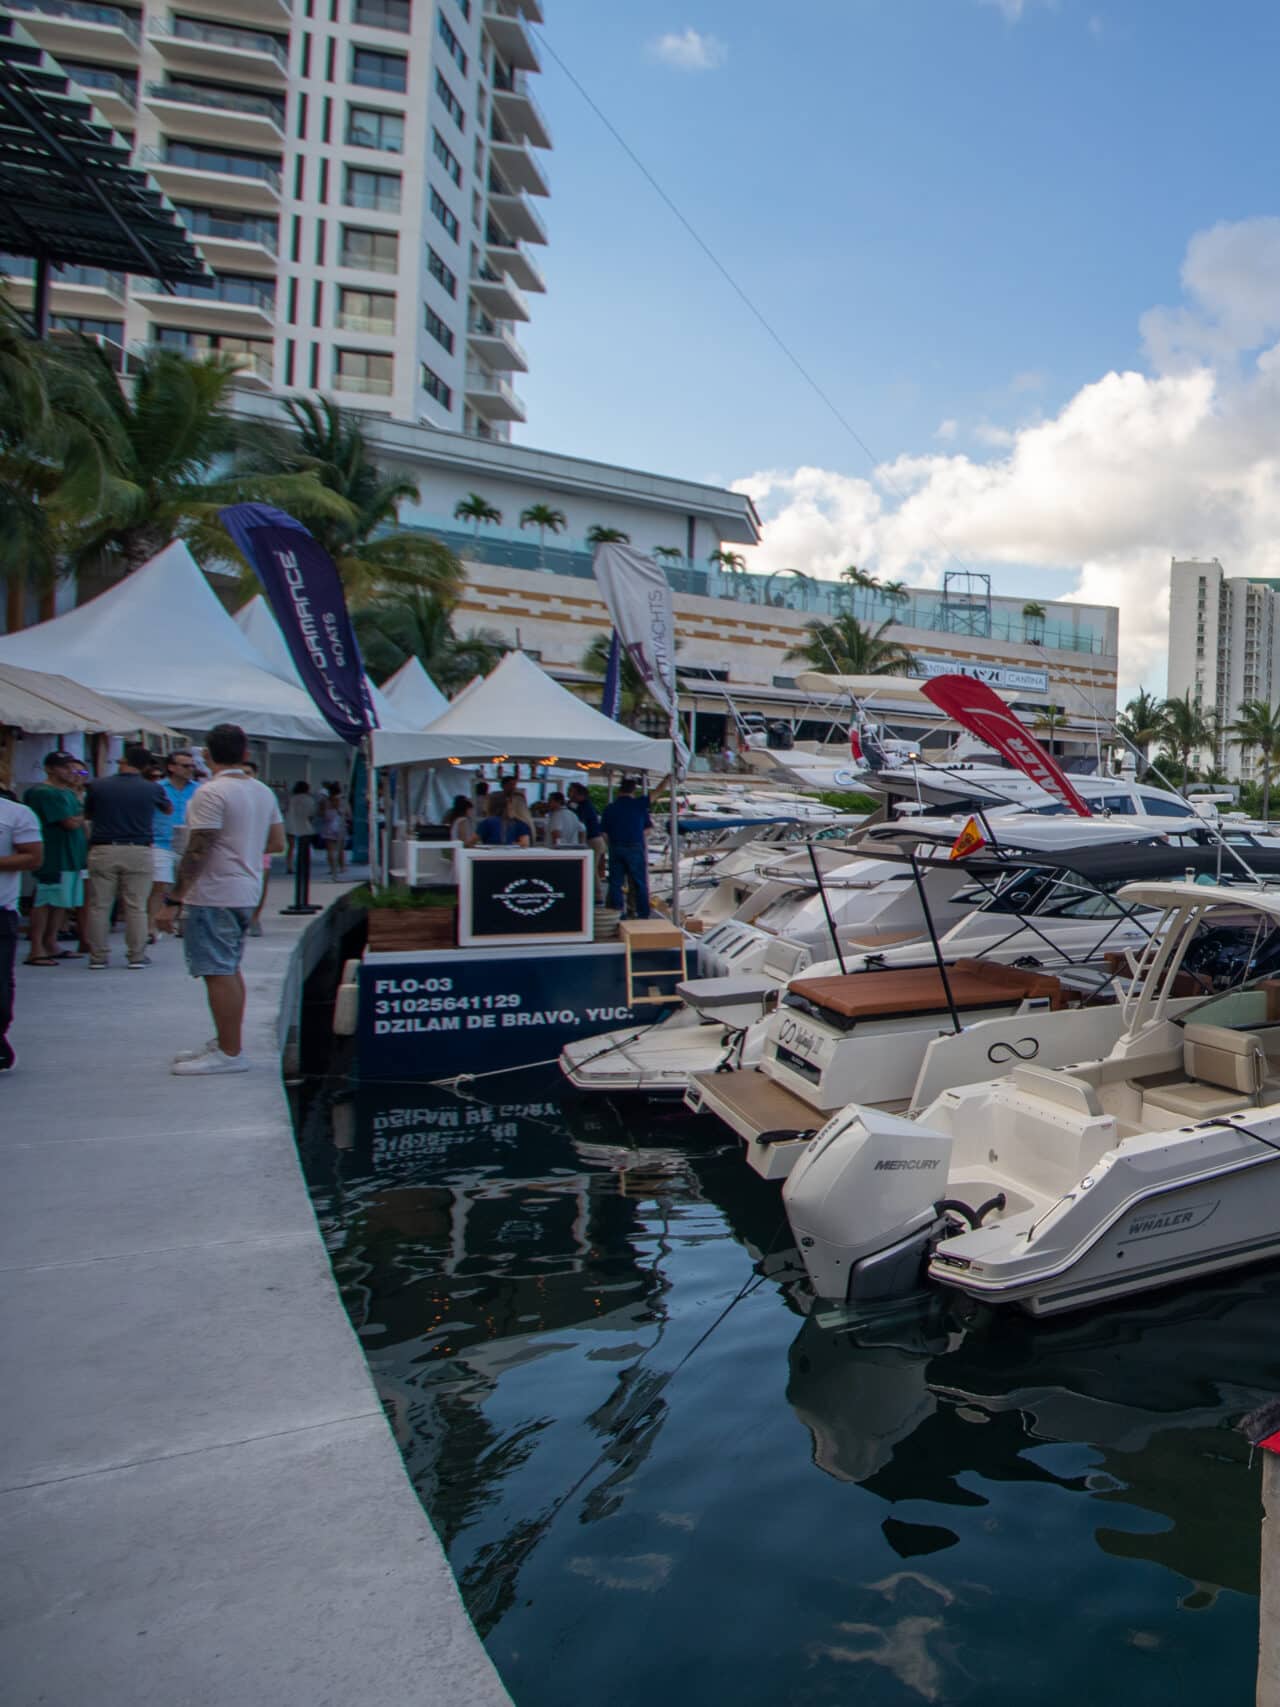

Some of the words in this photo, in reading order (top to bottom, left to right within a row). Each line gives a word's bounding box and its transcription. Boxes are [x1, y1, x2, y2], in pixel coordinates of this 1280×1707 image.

[375, 978, 453, 994] FLO-03
[375, 995, 521, 1014] 31025641129
[375, 1018, 460, 1034] DZILAM
[467, 1015, 496, 1029] DE
[501, 1010, 580, 1027] BRAVO,
[586, 1006, 634, 1021] YUC.
[874, 1159, 941, 1171] MERCURY
[1129, 1211, 1193, 1234] WHALER
